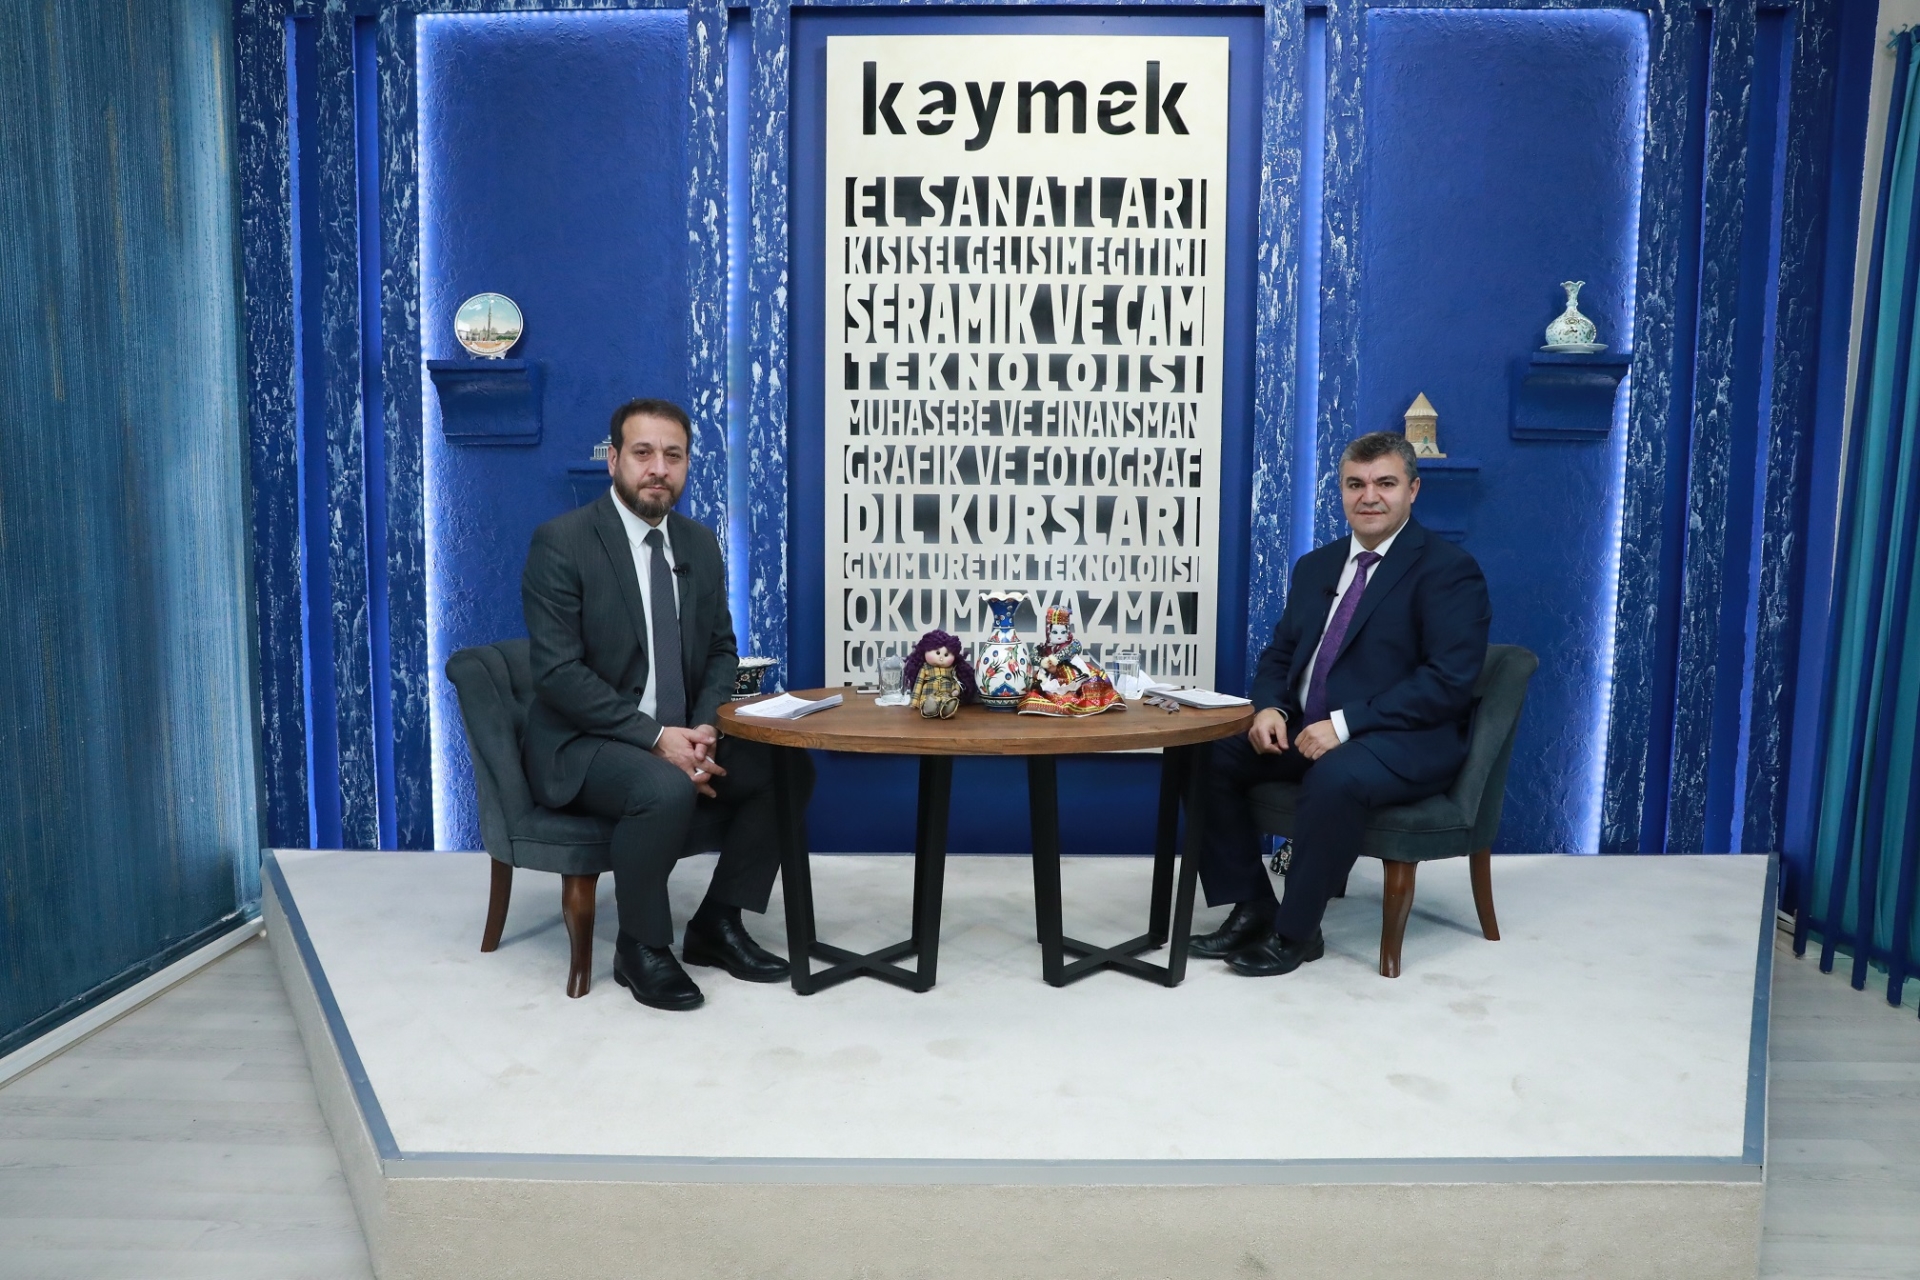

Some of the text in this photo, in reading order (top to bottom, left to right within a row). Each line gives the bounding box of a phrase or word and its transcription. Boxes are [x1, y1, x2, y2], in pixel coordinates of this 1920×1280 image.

[854, 176, 1201, 229] EL SANATLARI
[849, 236, 1201, 276] KISISEL GELISIM EGITIMI
[846, 283, 1202, 346] SERAMIK VE CAM
[850, 352, 1197, 393] TEKNOLOJISI
[849, 399, 1197, 438] MUHASEBE VE FINANSMAN
[845, 445, 1201, 487] GRAFIK VE FOTOGRAF
[848, 493, 1197, 546] DIL KURSLARI
[845, 552, 921, 580] GIYIM
[930, 553, 1029, 581] URETIM
